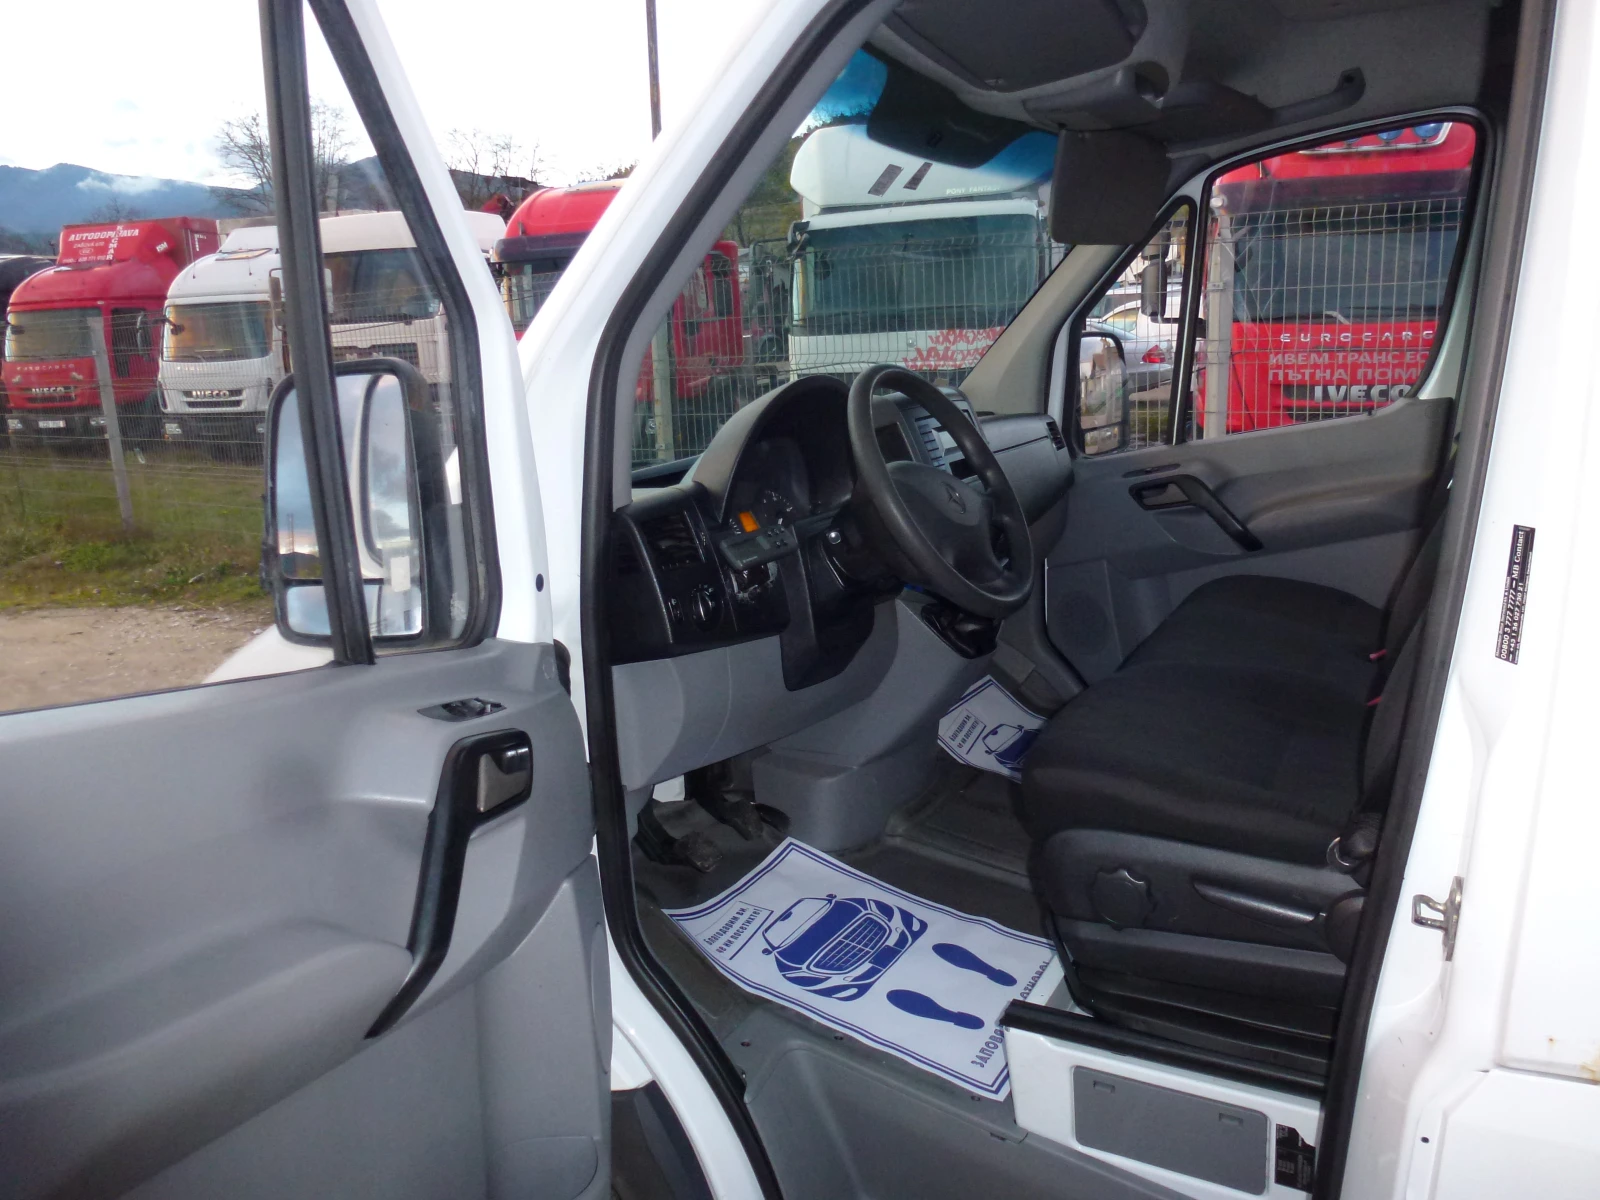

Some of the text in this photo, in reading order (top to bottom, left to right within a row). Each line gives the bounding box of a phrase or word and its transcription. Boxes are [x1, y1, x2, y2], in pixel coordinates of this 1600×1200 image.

[1280, 330, 1433, 342] EUROCARG
[1336, 351, 1400, 365] ТРАНС
[1269, 368, 1417, 381] ПЪТНА ПОМ
[191, 390, 229, 399] IVECO
[1314, 384, 1412, 403] IVECO
[1514, 531, 1524, 563] Contact
